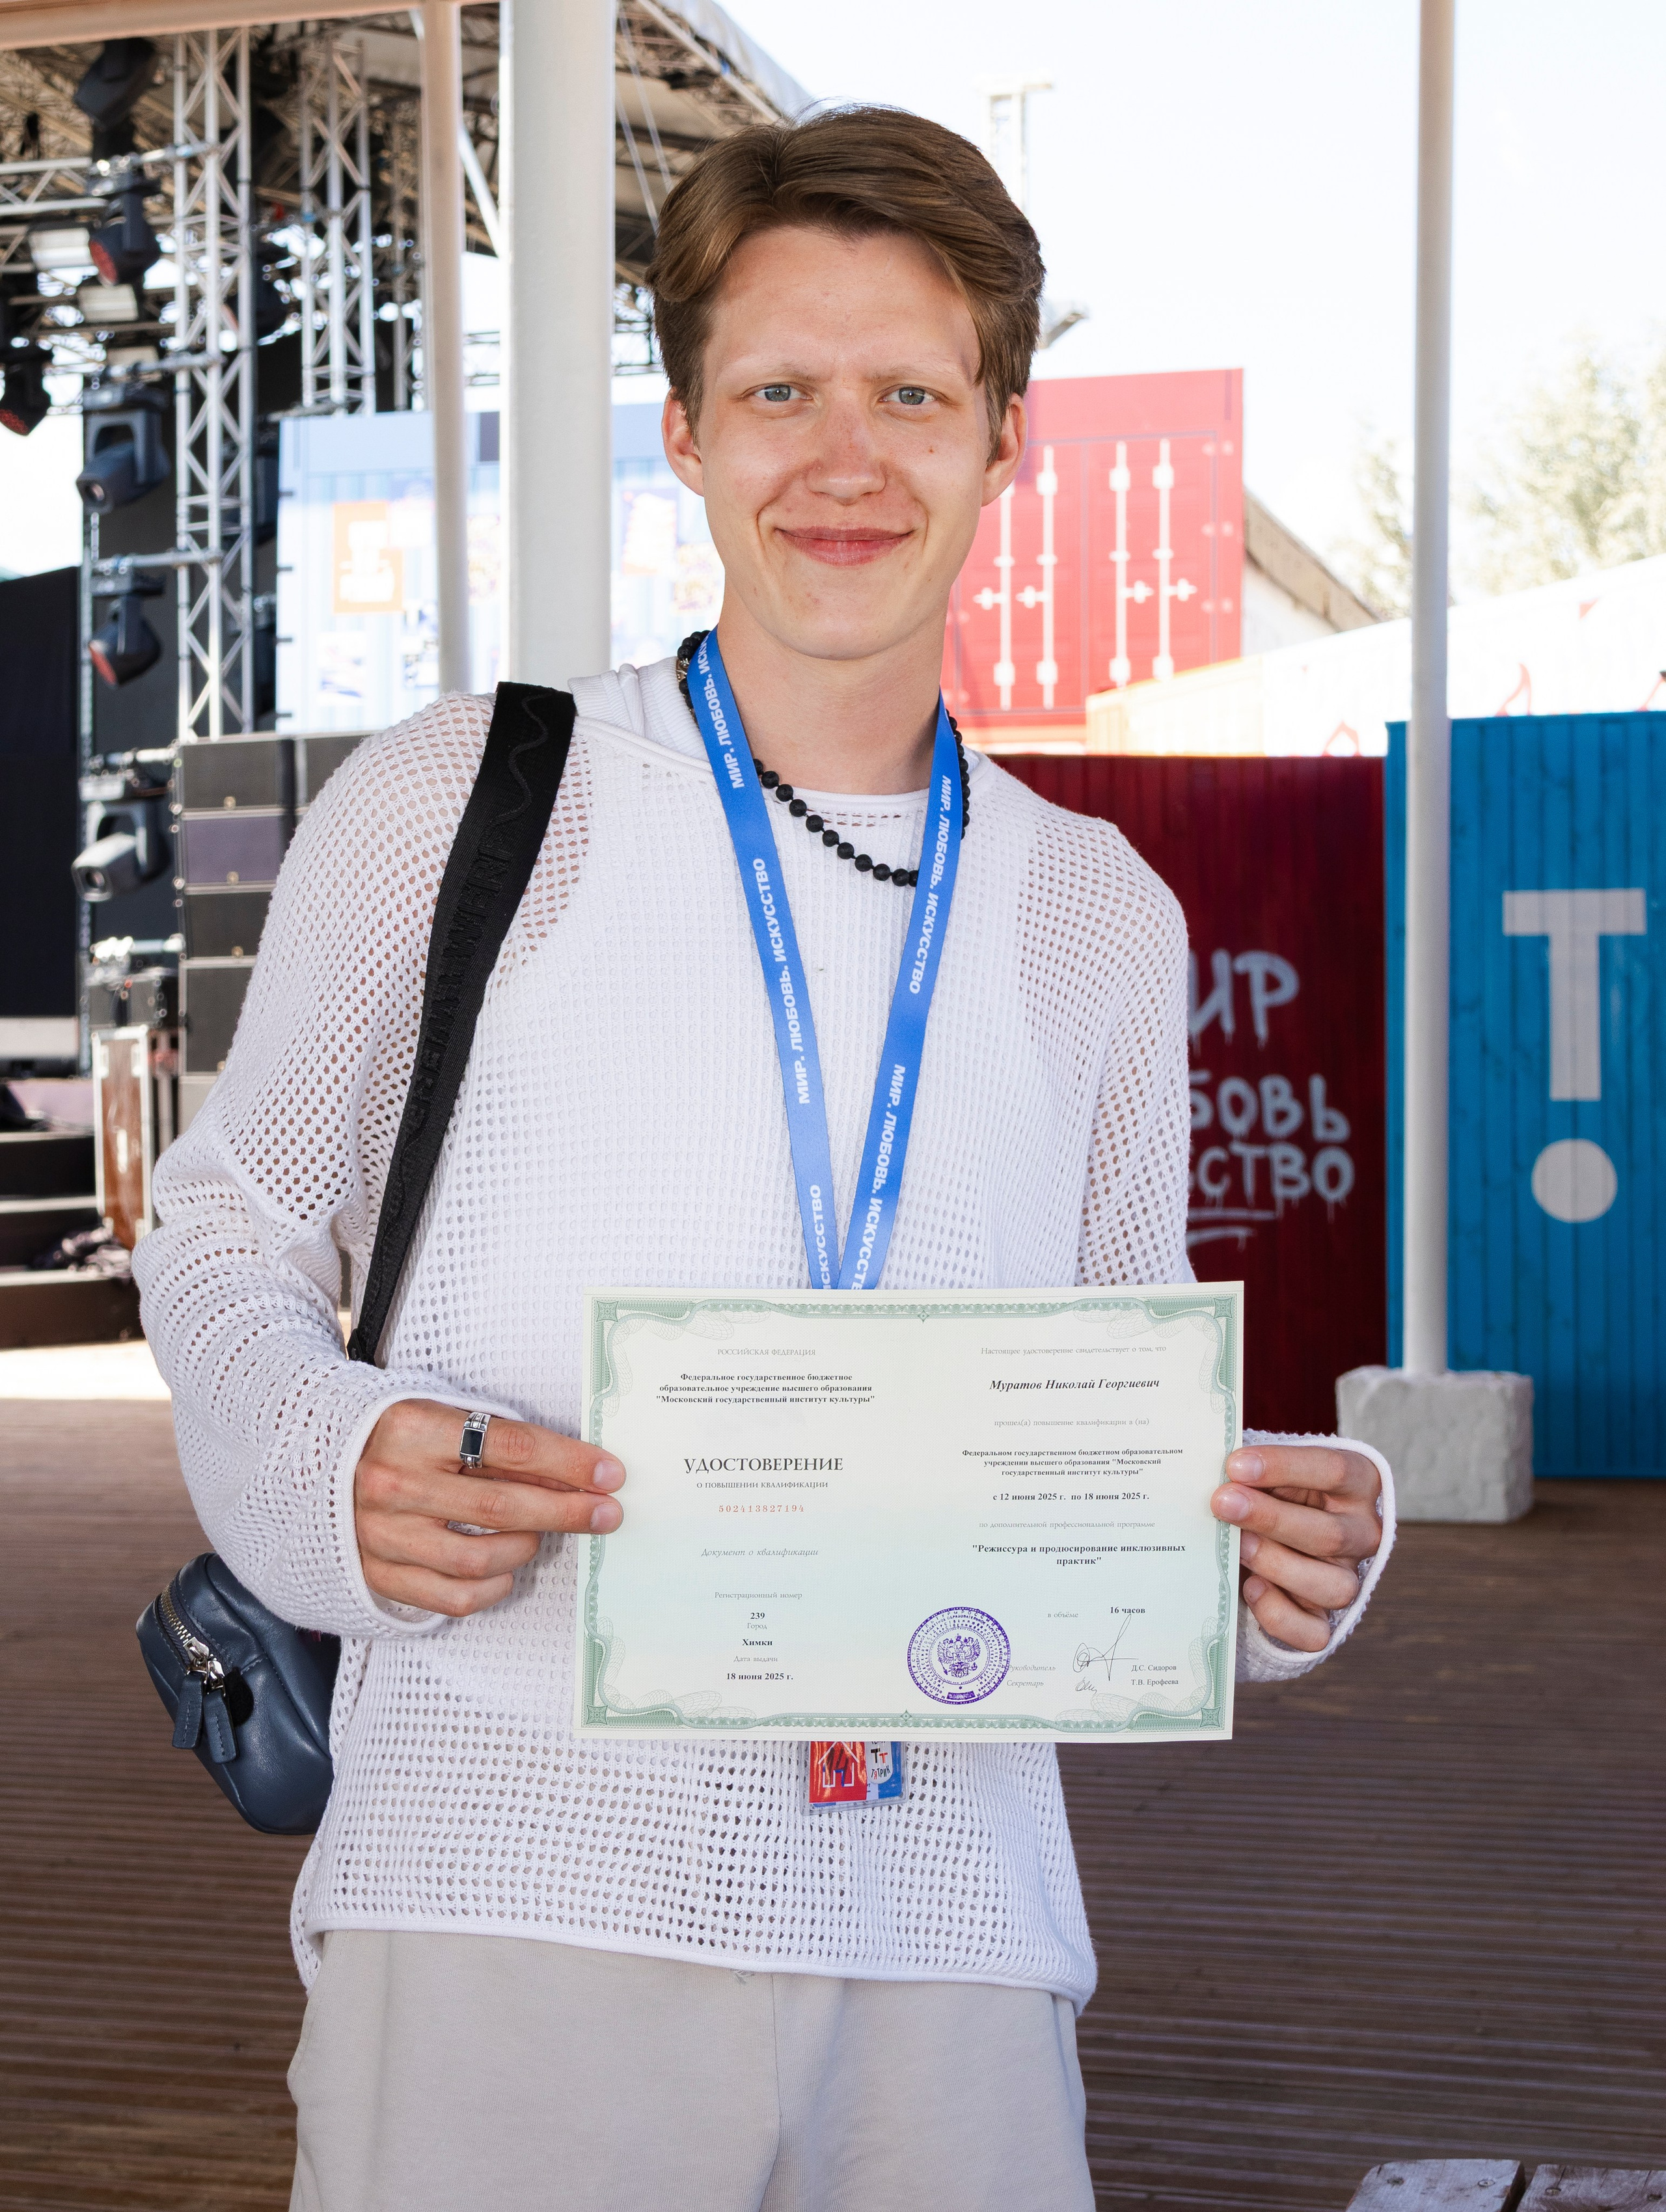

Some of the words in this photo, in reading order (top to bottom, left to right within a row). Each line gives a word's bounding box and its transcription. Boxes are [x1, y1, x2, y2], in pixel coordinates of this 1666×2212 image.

[703, 673, 735, 746] ЛЮБОВЬ.
[723, 747, 744, 789] МИР.
[940, 774, 952, 815] МИР.
[930, 815, 951, 890] ЛЮБОВЬ.
[752, 857, 787, 963] ИСКУССТВО
[910, 893, 939, 994] ИСКУССТВО
[779, 966, 802, 1052] ЛЮБОВЬ.
[1188, 948, 1300, 1044] ИР
[793, 1055, 810, 1104] МИР.
[886, 1063, 906, 1108] МИР.
[1189, 1068, 1350, 1143] БОВЬ
[871, 1112, 897, 1195] ЛЮБОВЬ.
[1188, 1141, 1355, 1205] СТВО
[851, 1197, 882, 1289] ИСКУССТВ
[771, 1348, 816, 1357] ФЕДЕРАЦИЯ
[659, 1384, 729, 1393] образовательное
[820, 1384, 872, 1393] образования
[680, 1373, 735, 1382] Федеральное
[989, 1380, 1043, 1391] Муратов
[1045, 1379, 1095, 1389] Николай
[1098, 1378, 1160, 1390] Георгиевич
[715, 1396, 787, 1404] государственный
[829, 1395, 875, 1404] культуры"
[683, 1458, 843, 1473] УДОСТОВЕРЕНИЕ
[1050, 1521, 1115, 1529] профессиональной
[700, 1548, 745, 1557] Документ
[756, 1548, 819, 1557] квалификации
[972, 1544, 1028, 1554] "Режиссура
[1039, 1546, 1118, 1554] продюсирование
[1056, 1557, 1102, 1566] практик"
[715, 1591, 778, 1600] Регистрационный
[1006, 1679, 1045, 1687] Секретарь
